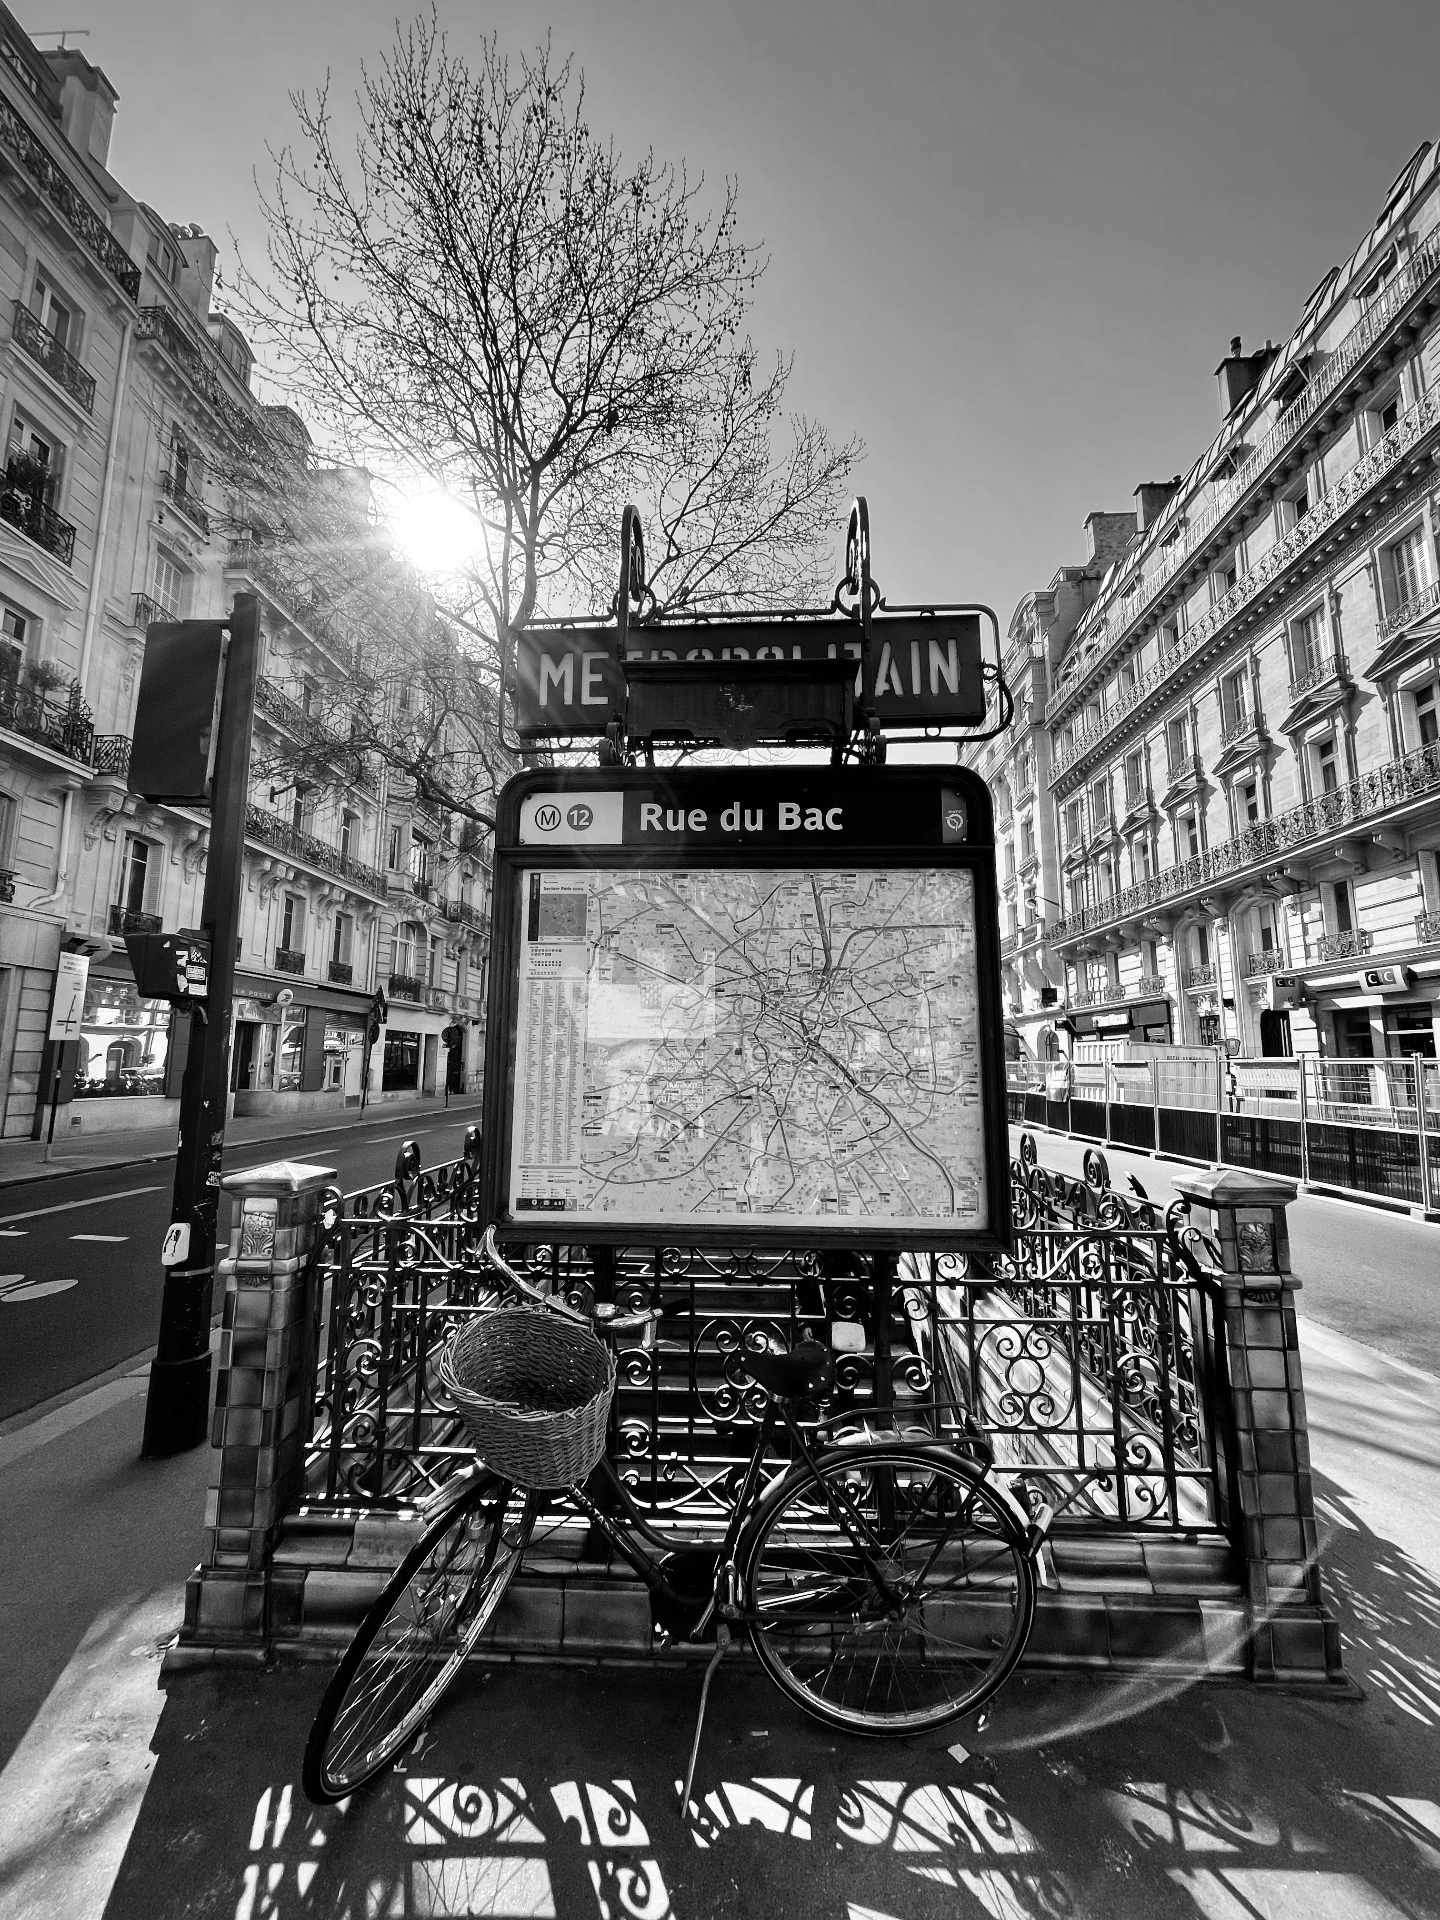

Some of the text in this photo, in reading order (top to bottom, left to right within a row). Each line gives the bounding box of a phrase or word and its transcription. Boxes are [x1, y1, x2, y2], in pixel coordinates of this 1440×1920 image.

[570, 809, 590, 826] 12
[640, 802, 843, 832] Rue du Bac
